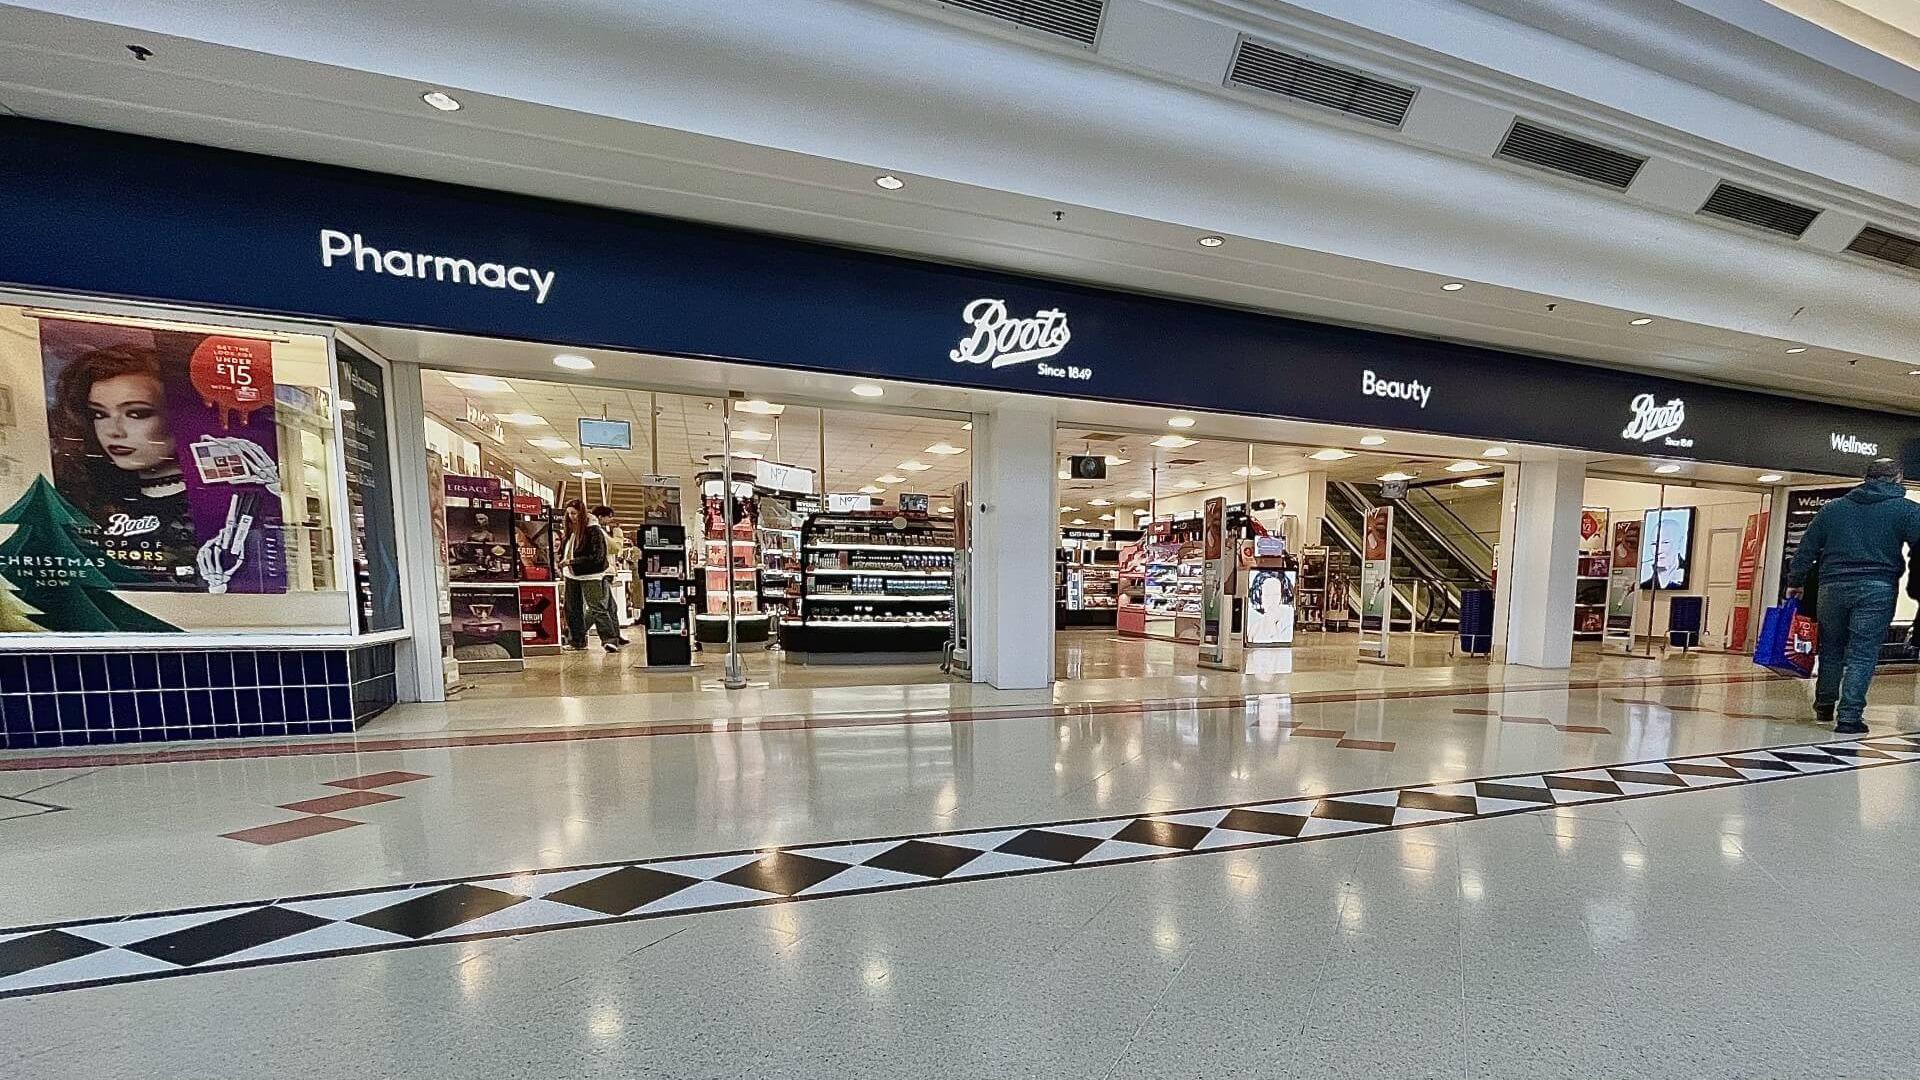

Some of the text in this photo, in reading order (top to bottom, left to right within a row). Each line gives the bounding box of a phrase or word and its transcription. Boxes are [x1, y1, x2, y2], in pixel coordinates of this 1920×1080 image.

[321, 228, 555, 304] Pharmacy
[950, 298, 1071, 369] Boots
[215, 356, 252, 365] UNDER
[216, 363, 252, 386] £15
[1037, 363, 1092, 380] Since 1849
[1362, 369, 1431, 409] Beauty
[1622, 393, 1685, 442] Boots
[1830, 432, 1878, 456] Wellness
[447, 484, 489, 493] ERSACE
[1798, 496, 1832, 507] Welc
[104, 513, 160, 537] Boots
[140, 541, 162, 549] OF
[0, 555, 106, 568] CHRISTMAS
[106, 549, 163, 561] RRORS
[17, 568, 87, 578] IN STORE
[35, 579, 71, 587] NOW
